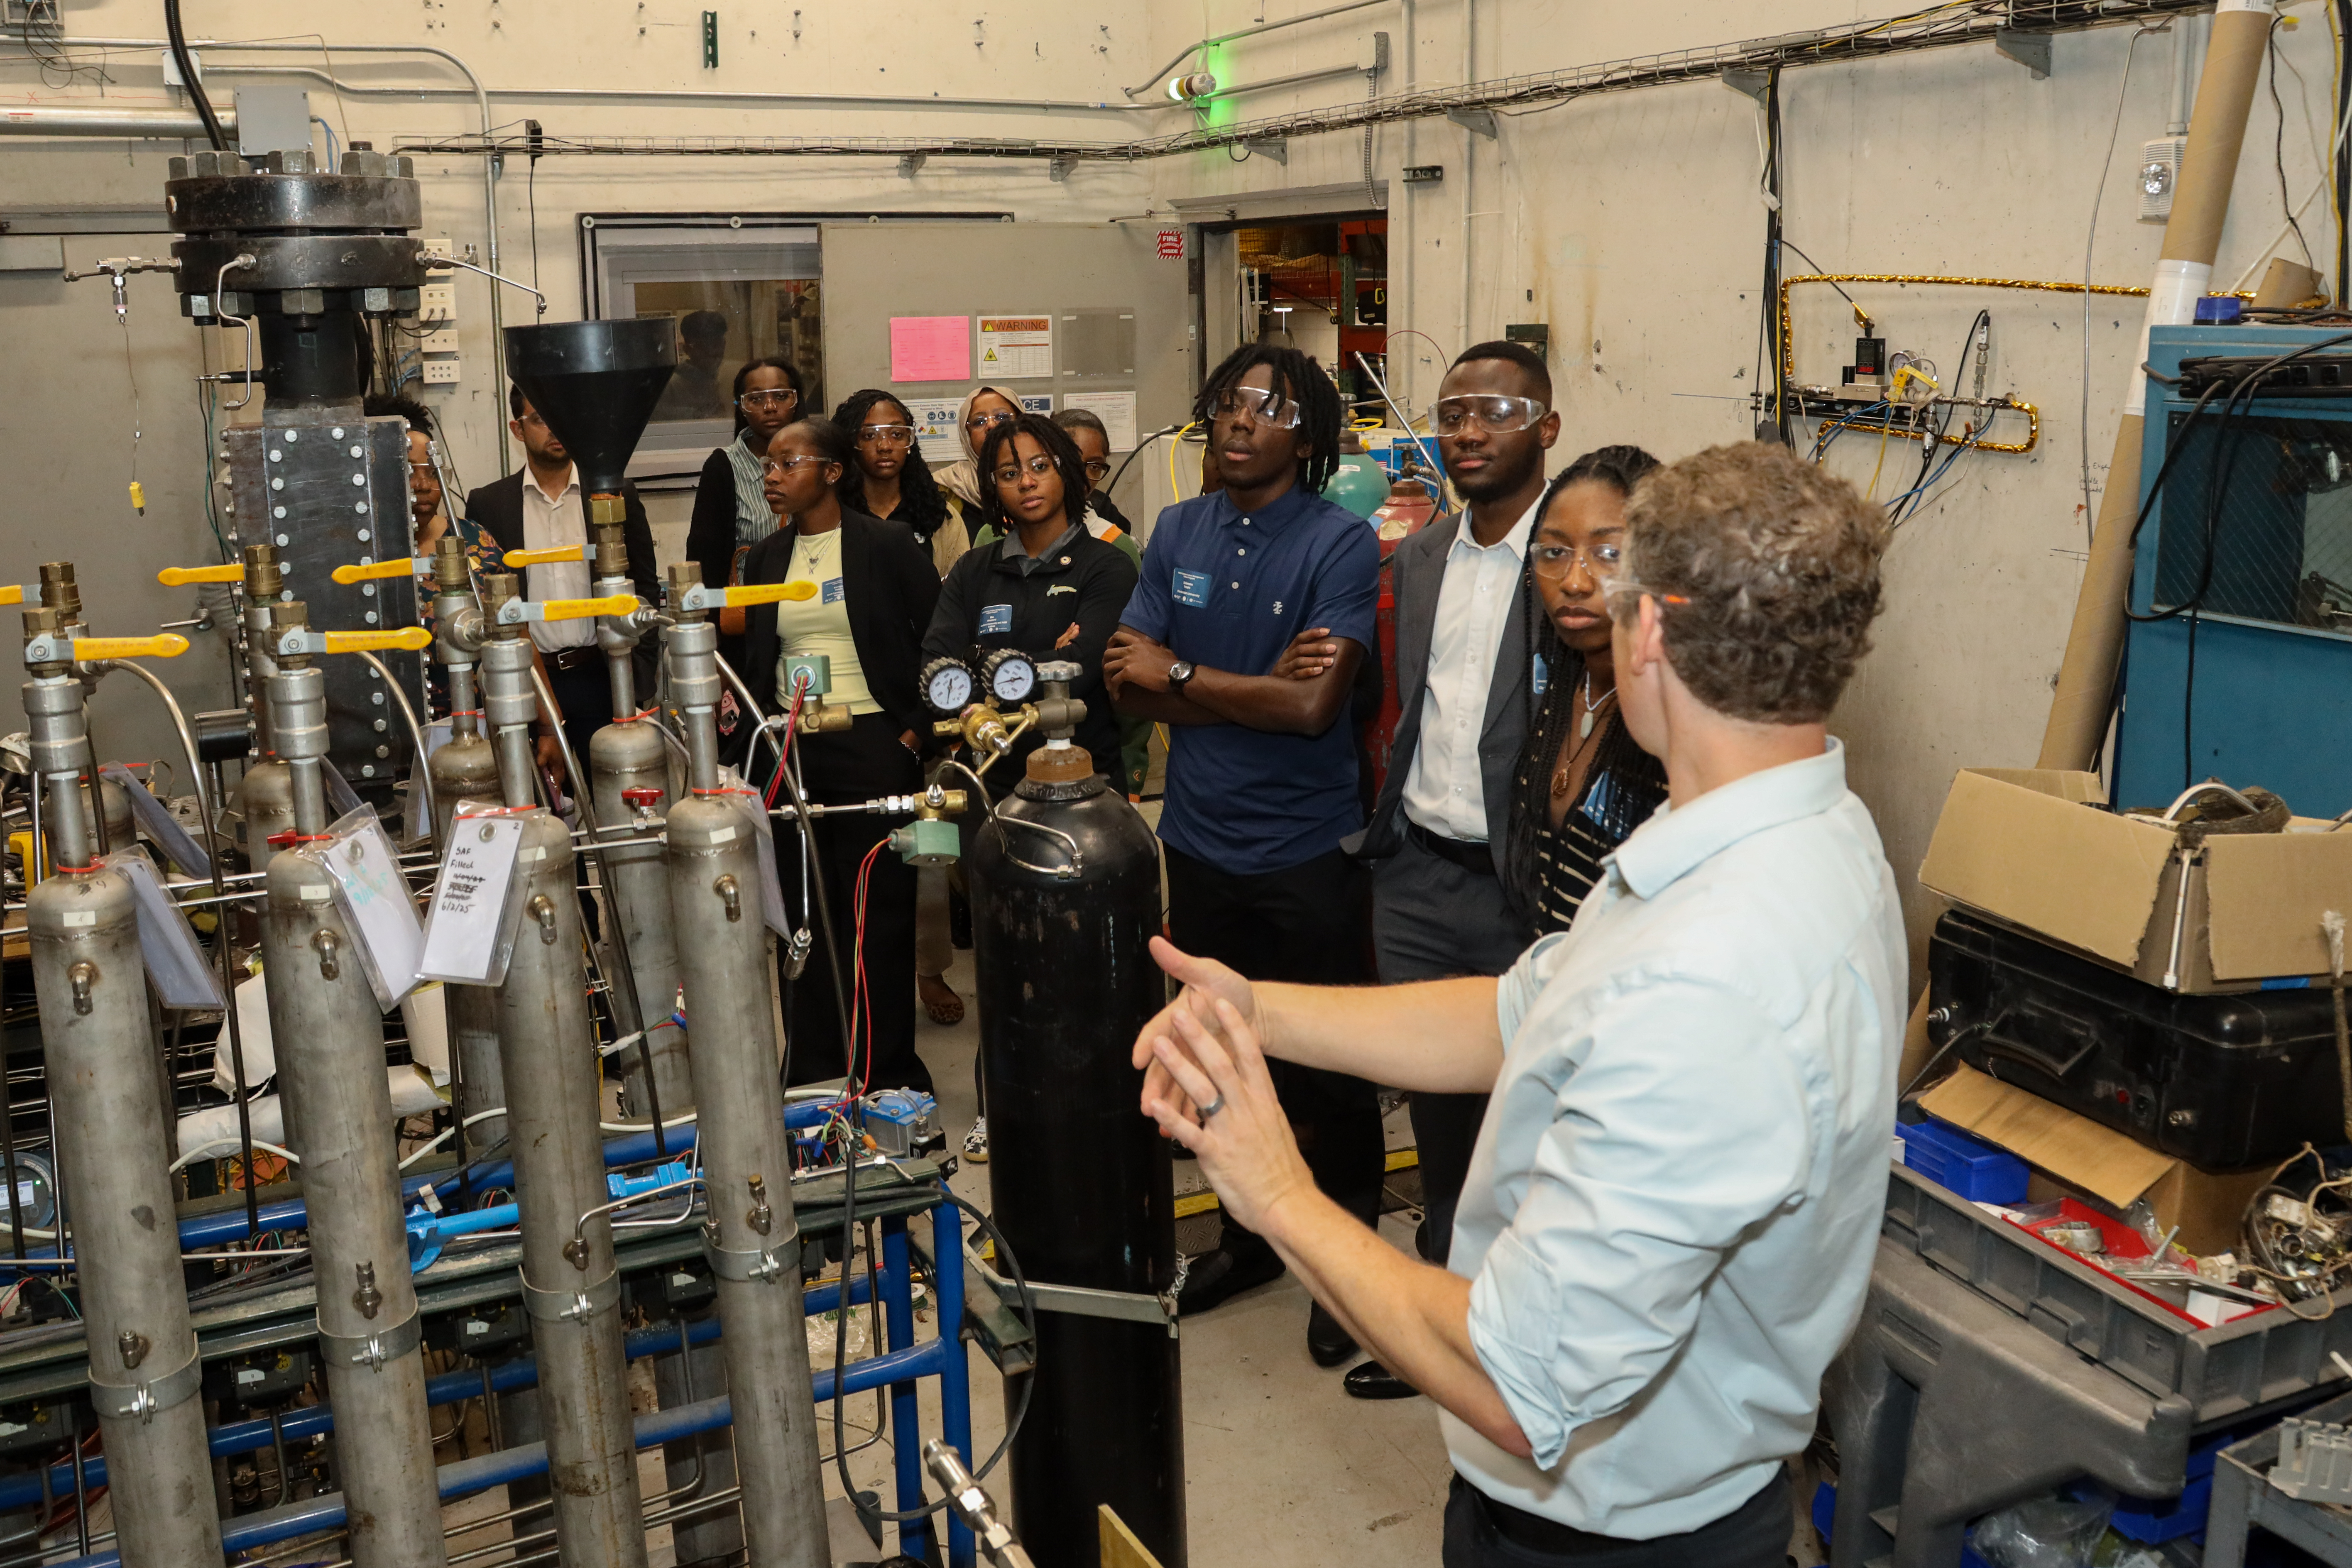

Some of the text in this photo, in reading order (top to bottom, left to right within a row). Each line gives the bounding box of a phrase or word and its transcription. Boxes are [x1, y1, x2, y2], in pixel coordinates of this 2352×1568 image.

[996, 321, 1046, 330] WARNING
[450, 859, 474, 869] Filled
[441, 902, 476, 913] 6/2/25
